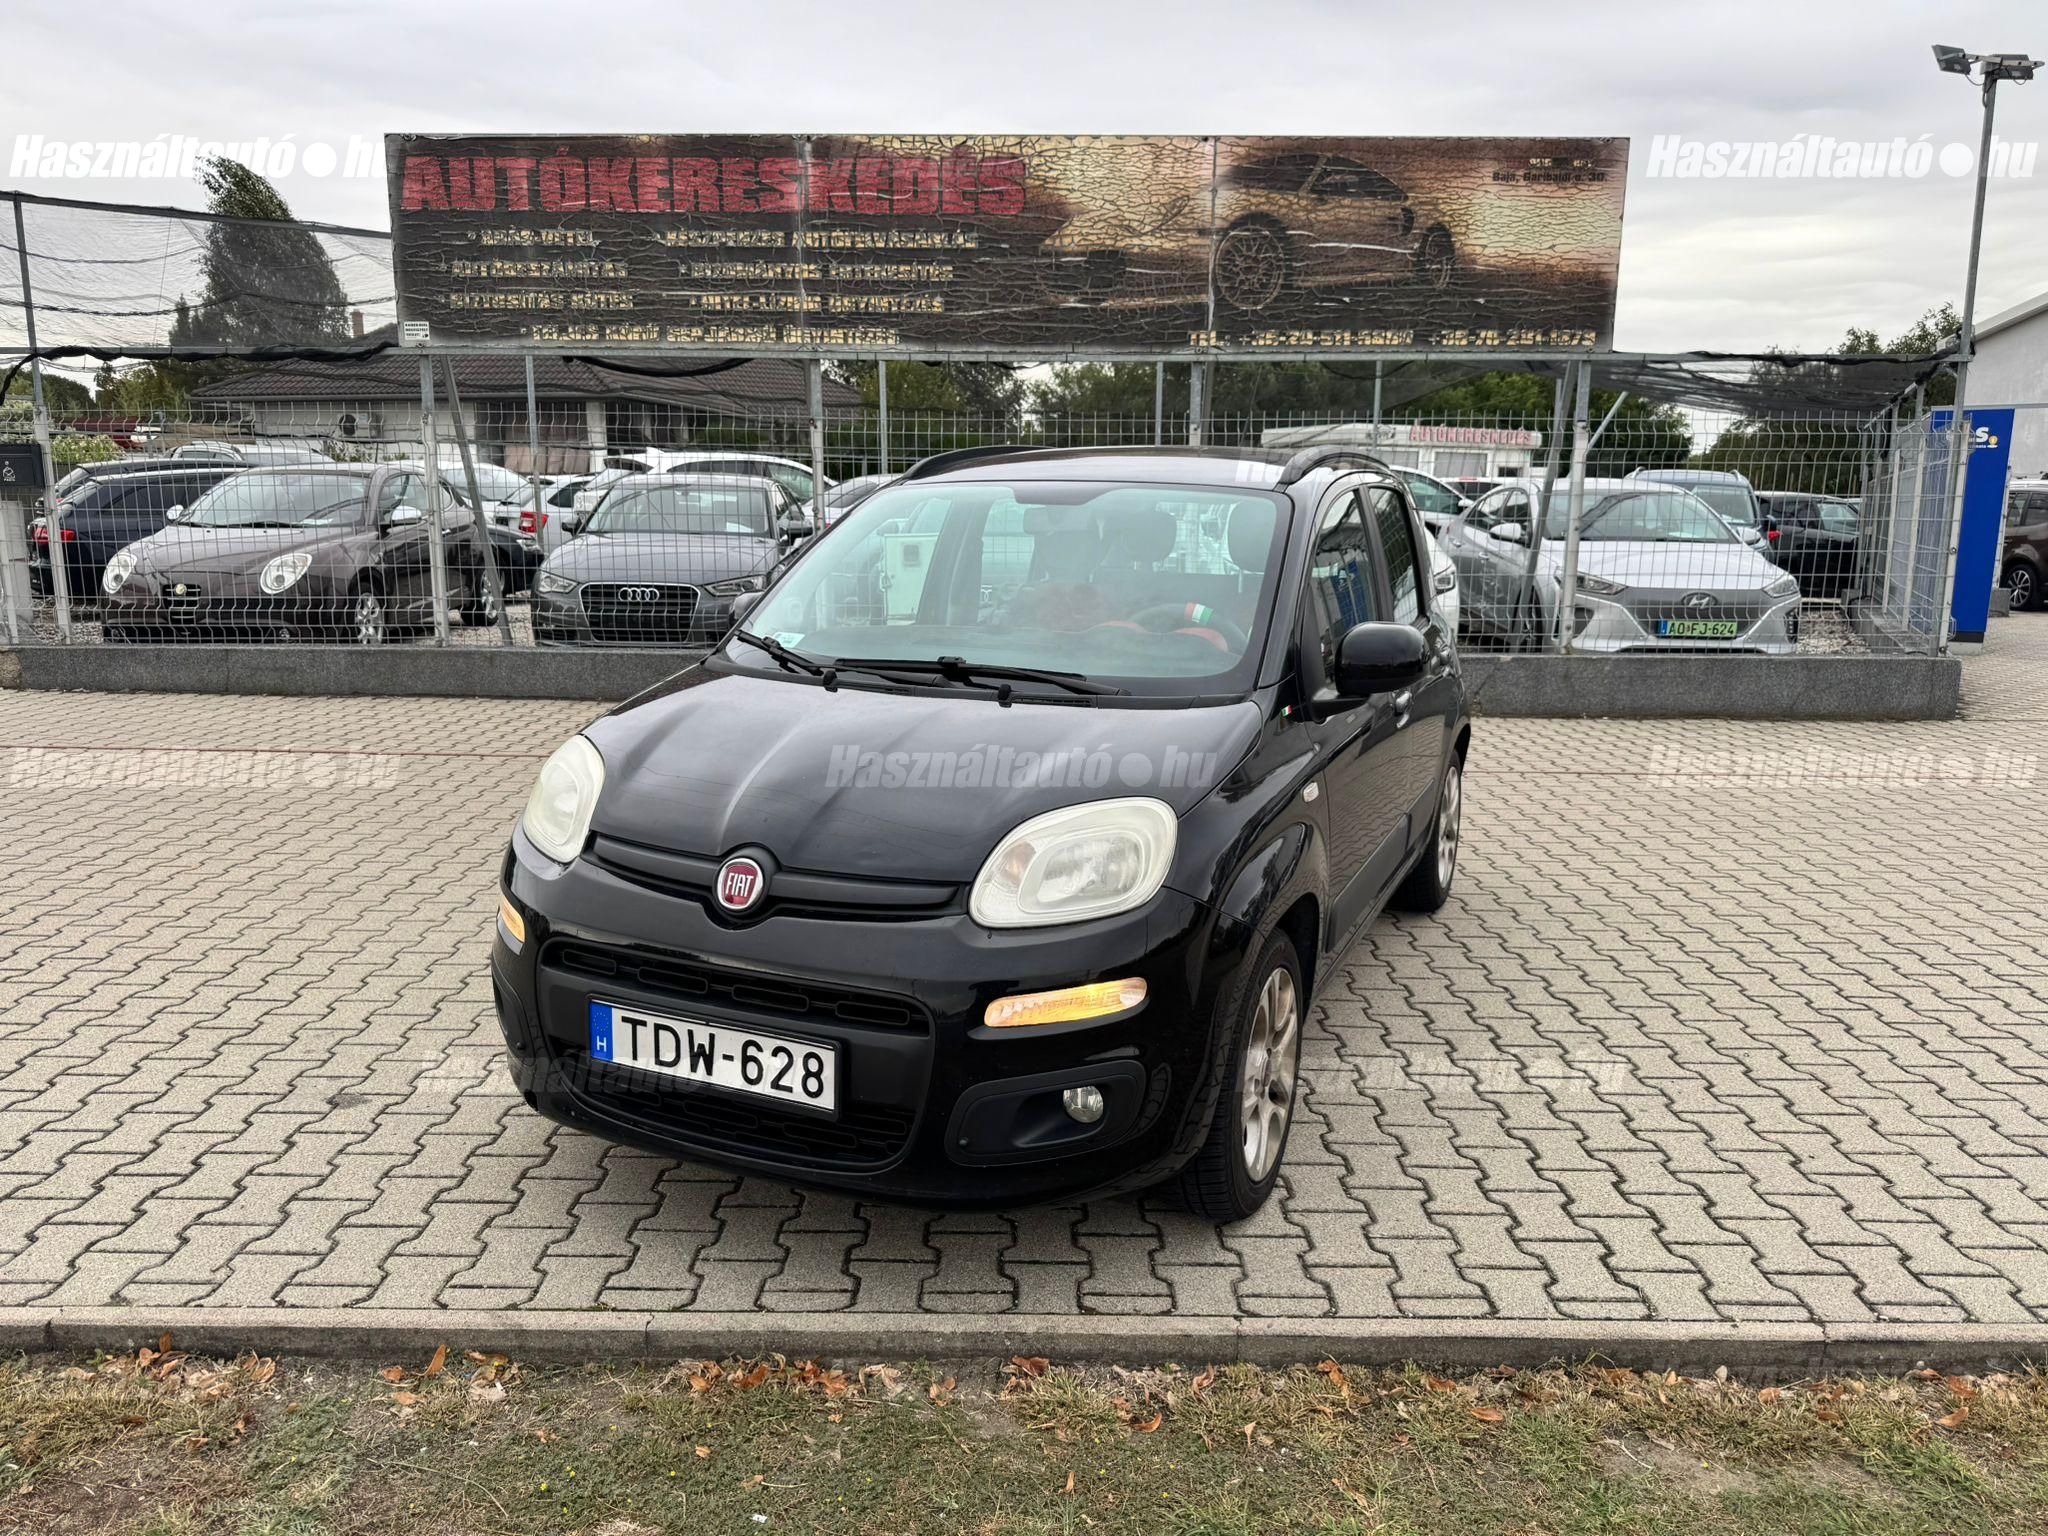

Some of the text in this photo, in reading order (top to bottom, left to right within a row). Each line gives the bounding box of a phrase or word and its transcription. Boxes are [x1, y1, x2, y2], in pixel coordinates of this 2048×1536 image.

[401, 146, 1026, 215] AUTÓKERESKEDÉS
[725, 872, 754, 897] FIAT
[596, 1015, 824, 1098] H TDW-628
